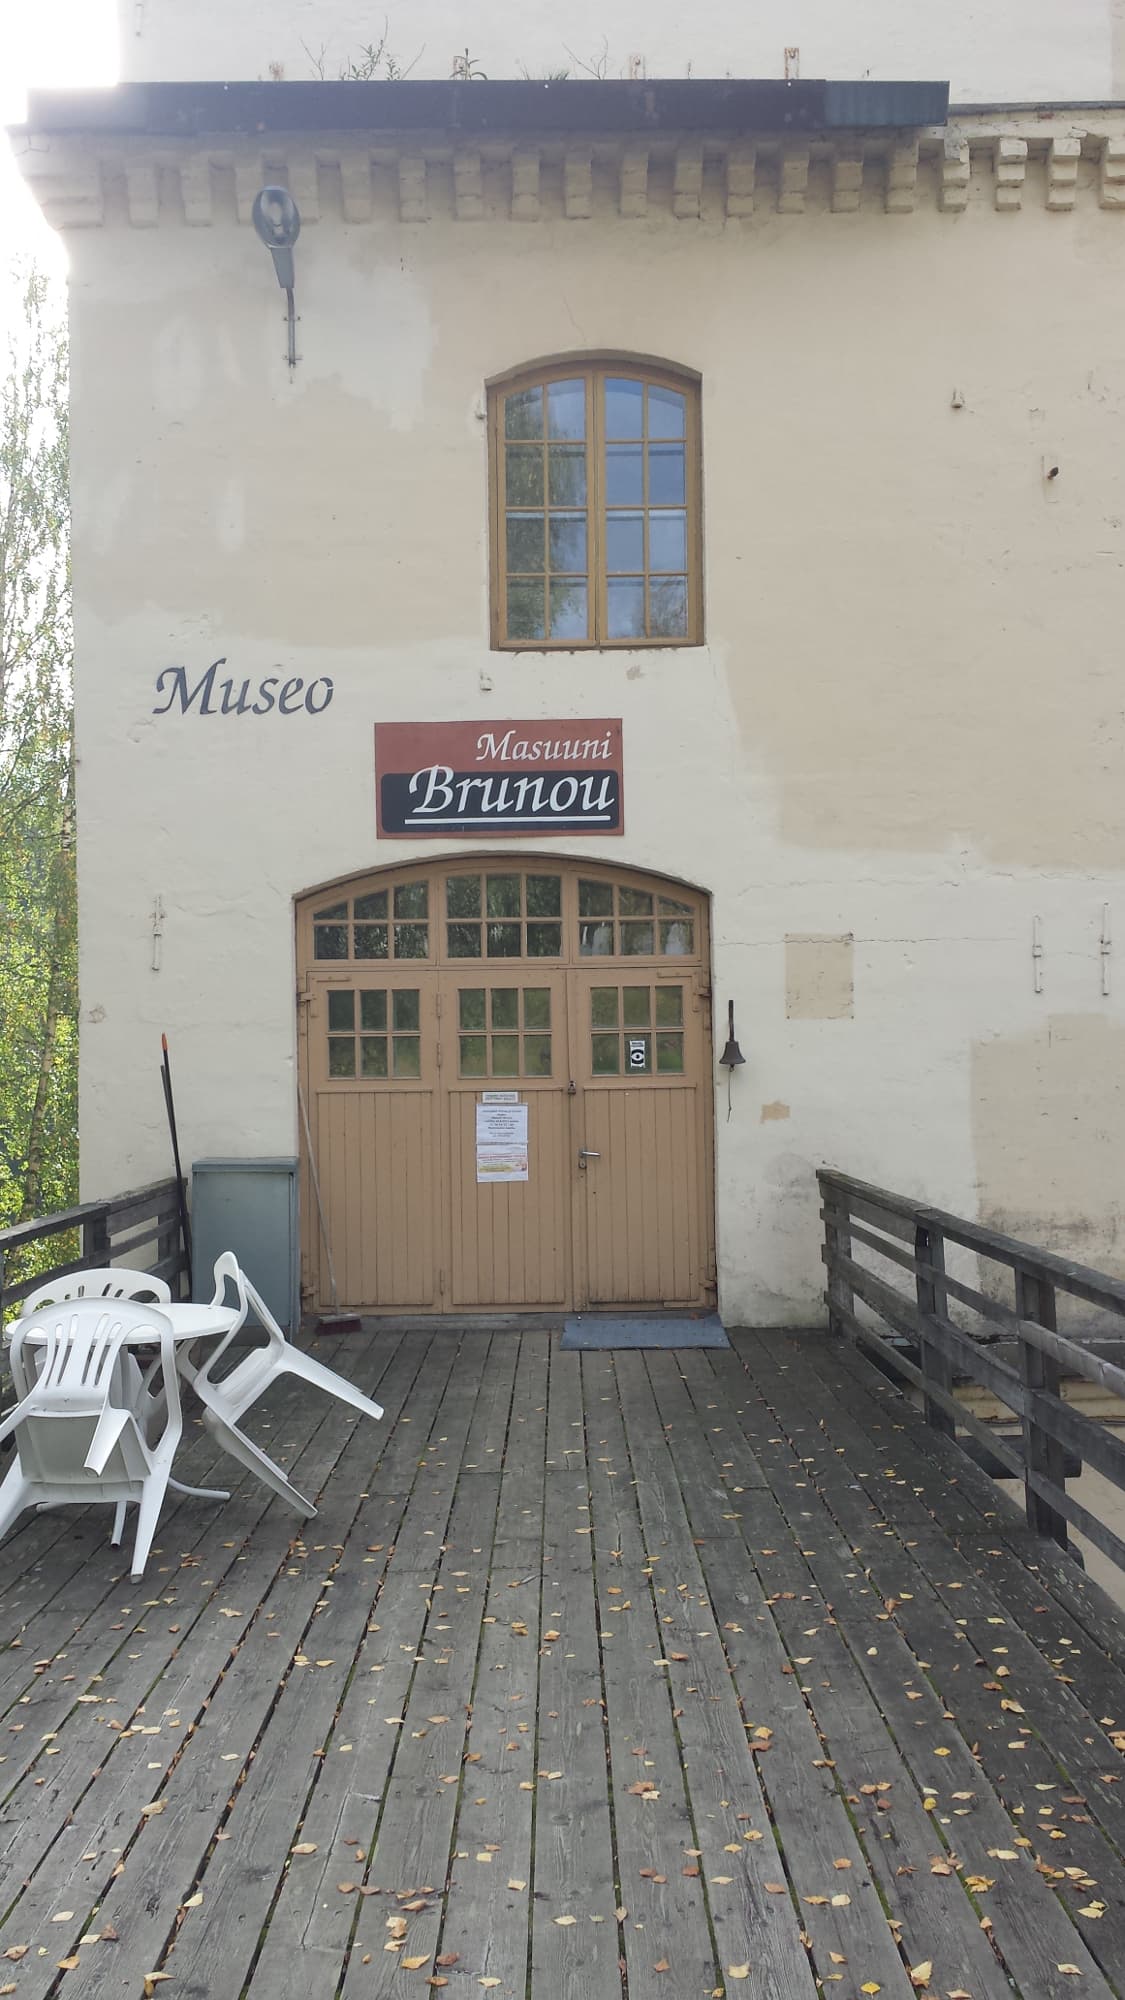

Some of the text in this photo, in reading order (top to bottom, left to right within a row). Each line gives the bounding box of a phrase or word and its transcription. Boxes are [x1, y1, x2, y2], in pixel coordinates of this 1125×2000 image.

[152, 657, 334, 715] Museo
[476, 730, 612, 761] Masuuni
[408, 764, 615, 813] Brunou
